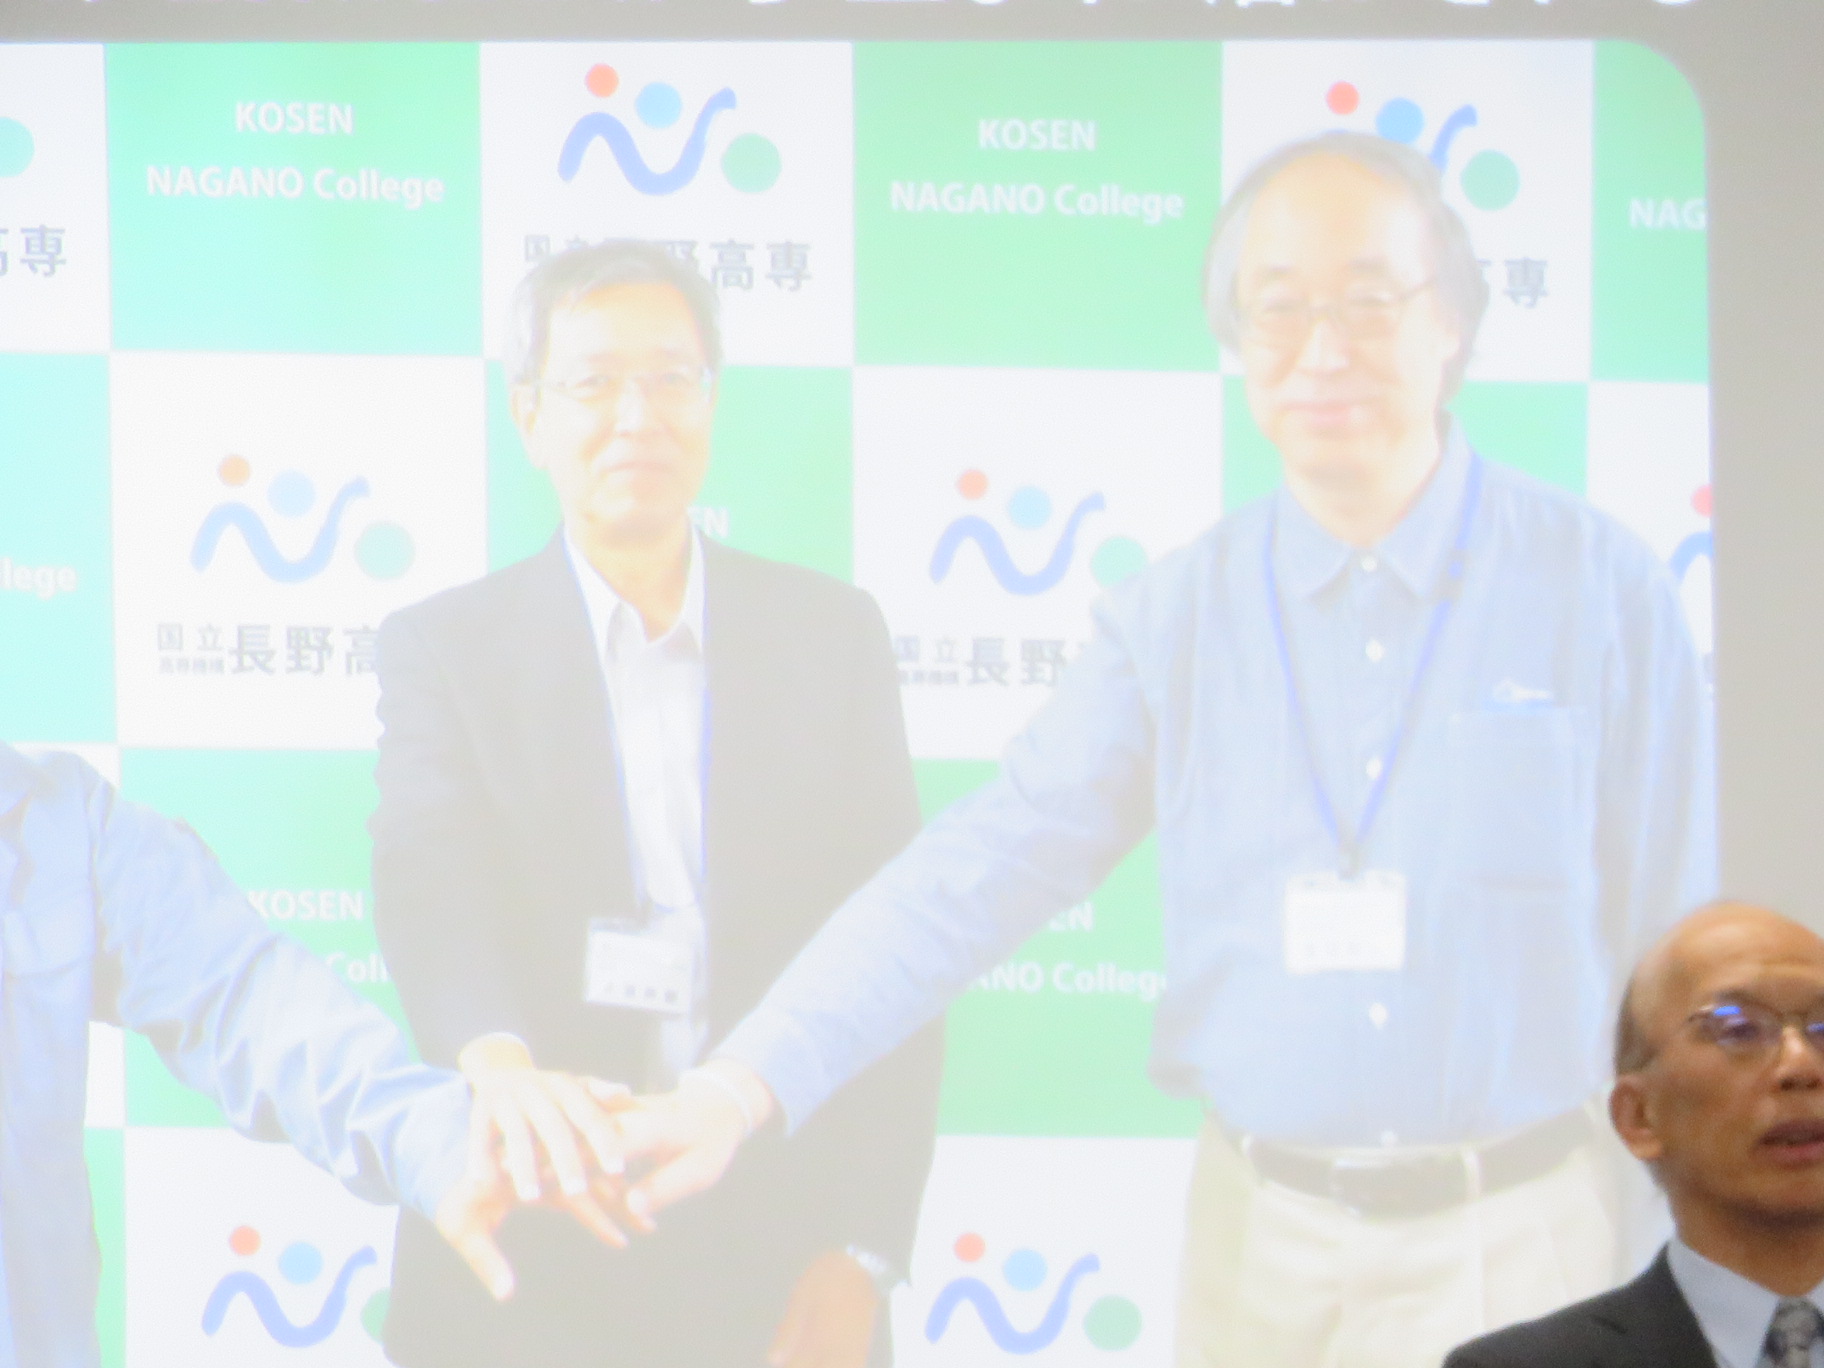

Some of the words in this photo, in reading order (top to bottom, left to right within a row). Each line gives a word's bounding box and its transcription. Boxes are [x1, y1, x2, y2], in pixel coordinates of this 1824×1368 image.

[236, 102, 354, 134] KOSEN
[979, 119, 1097, 150] KOSEN
[146, 165, 305, 198] NAGANO
[313, 168, 445, 210] College
[891, 182, 1046, 214] NAGANO
[1054, 184, 1185, 224] College
[0, 224, 67, 277] 専
[965, 637, 1084, 687] 長野
